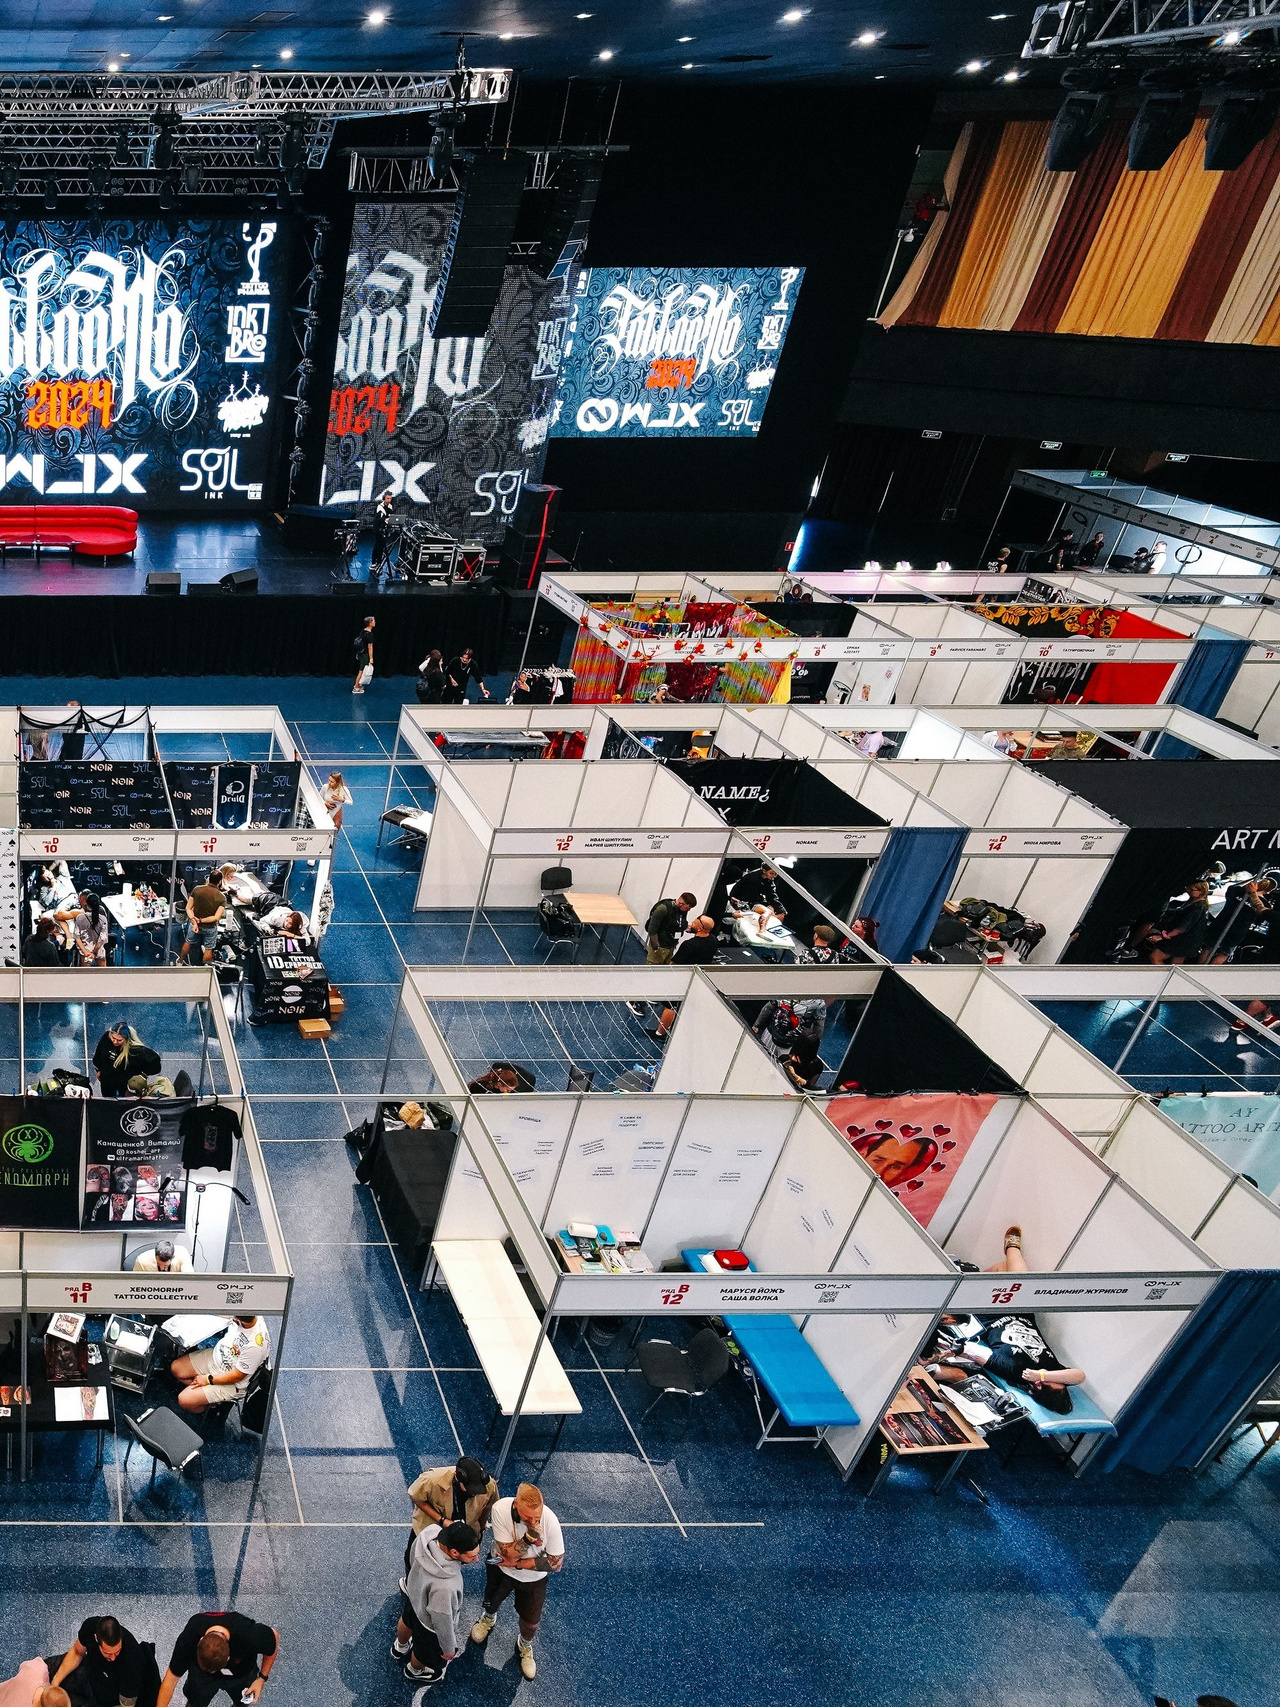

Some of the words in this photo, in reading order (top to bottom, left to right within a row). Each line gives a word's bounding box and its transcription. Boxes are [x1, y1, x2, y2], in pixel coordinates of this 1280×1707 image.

[646, 359, 697, 389] 2024
[25, 378, 115, 430] 2024
[1210, 829, 1269, 850] ART
[44, 844, 58, 853] 10
[202, 844, 214, 853] 11
[556, 843, 570, 851] 12
[988, 843, 1002, 851] 14
[278, 1006, 306, 1014] NOIR
[1229, 1107, 1259, 1118] AY
[97, 1139, 145, 1148] Канащенков
[148, 1138, 181, 1146] Виталий
[81, 1282, 92, 1291] B
[677, 1284, 690, 1293] B
[757, 1286, 785, 1294] ЙОЖЪ
[1009, 1283, 1022, 1292] B
[69, 1292, 88, 1303] 11
[661, 1294, 684, 1305] 12
[991, 1293, 1014, 1304] 13
